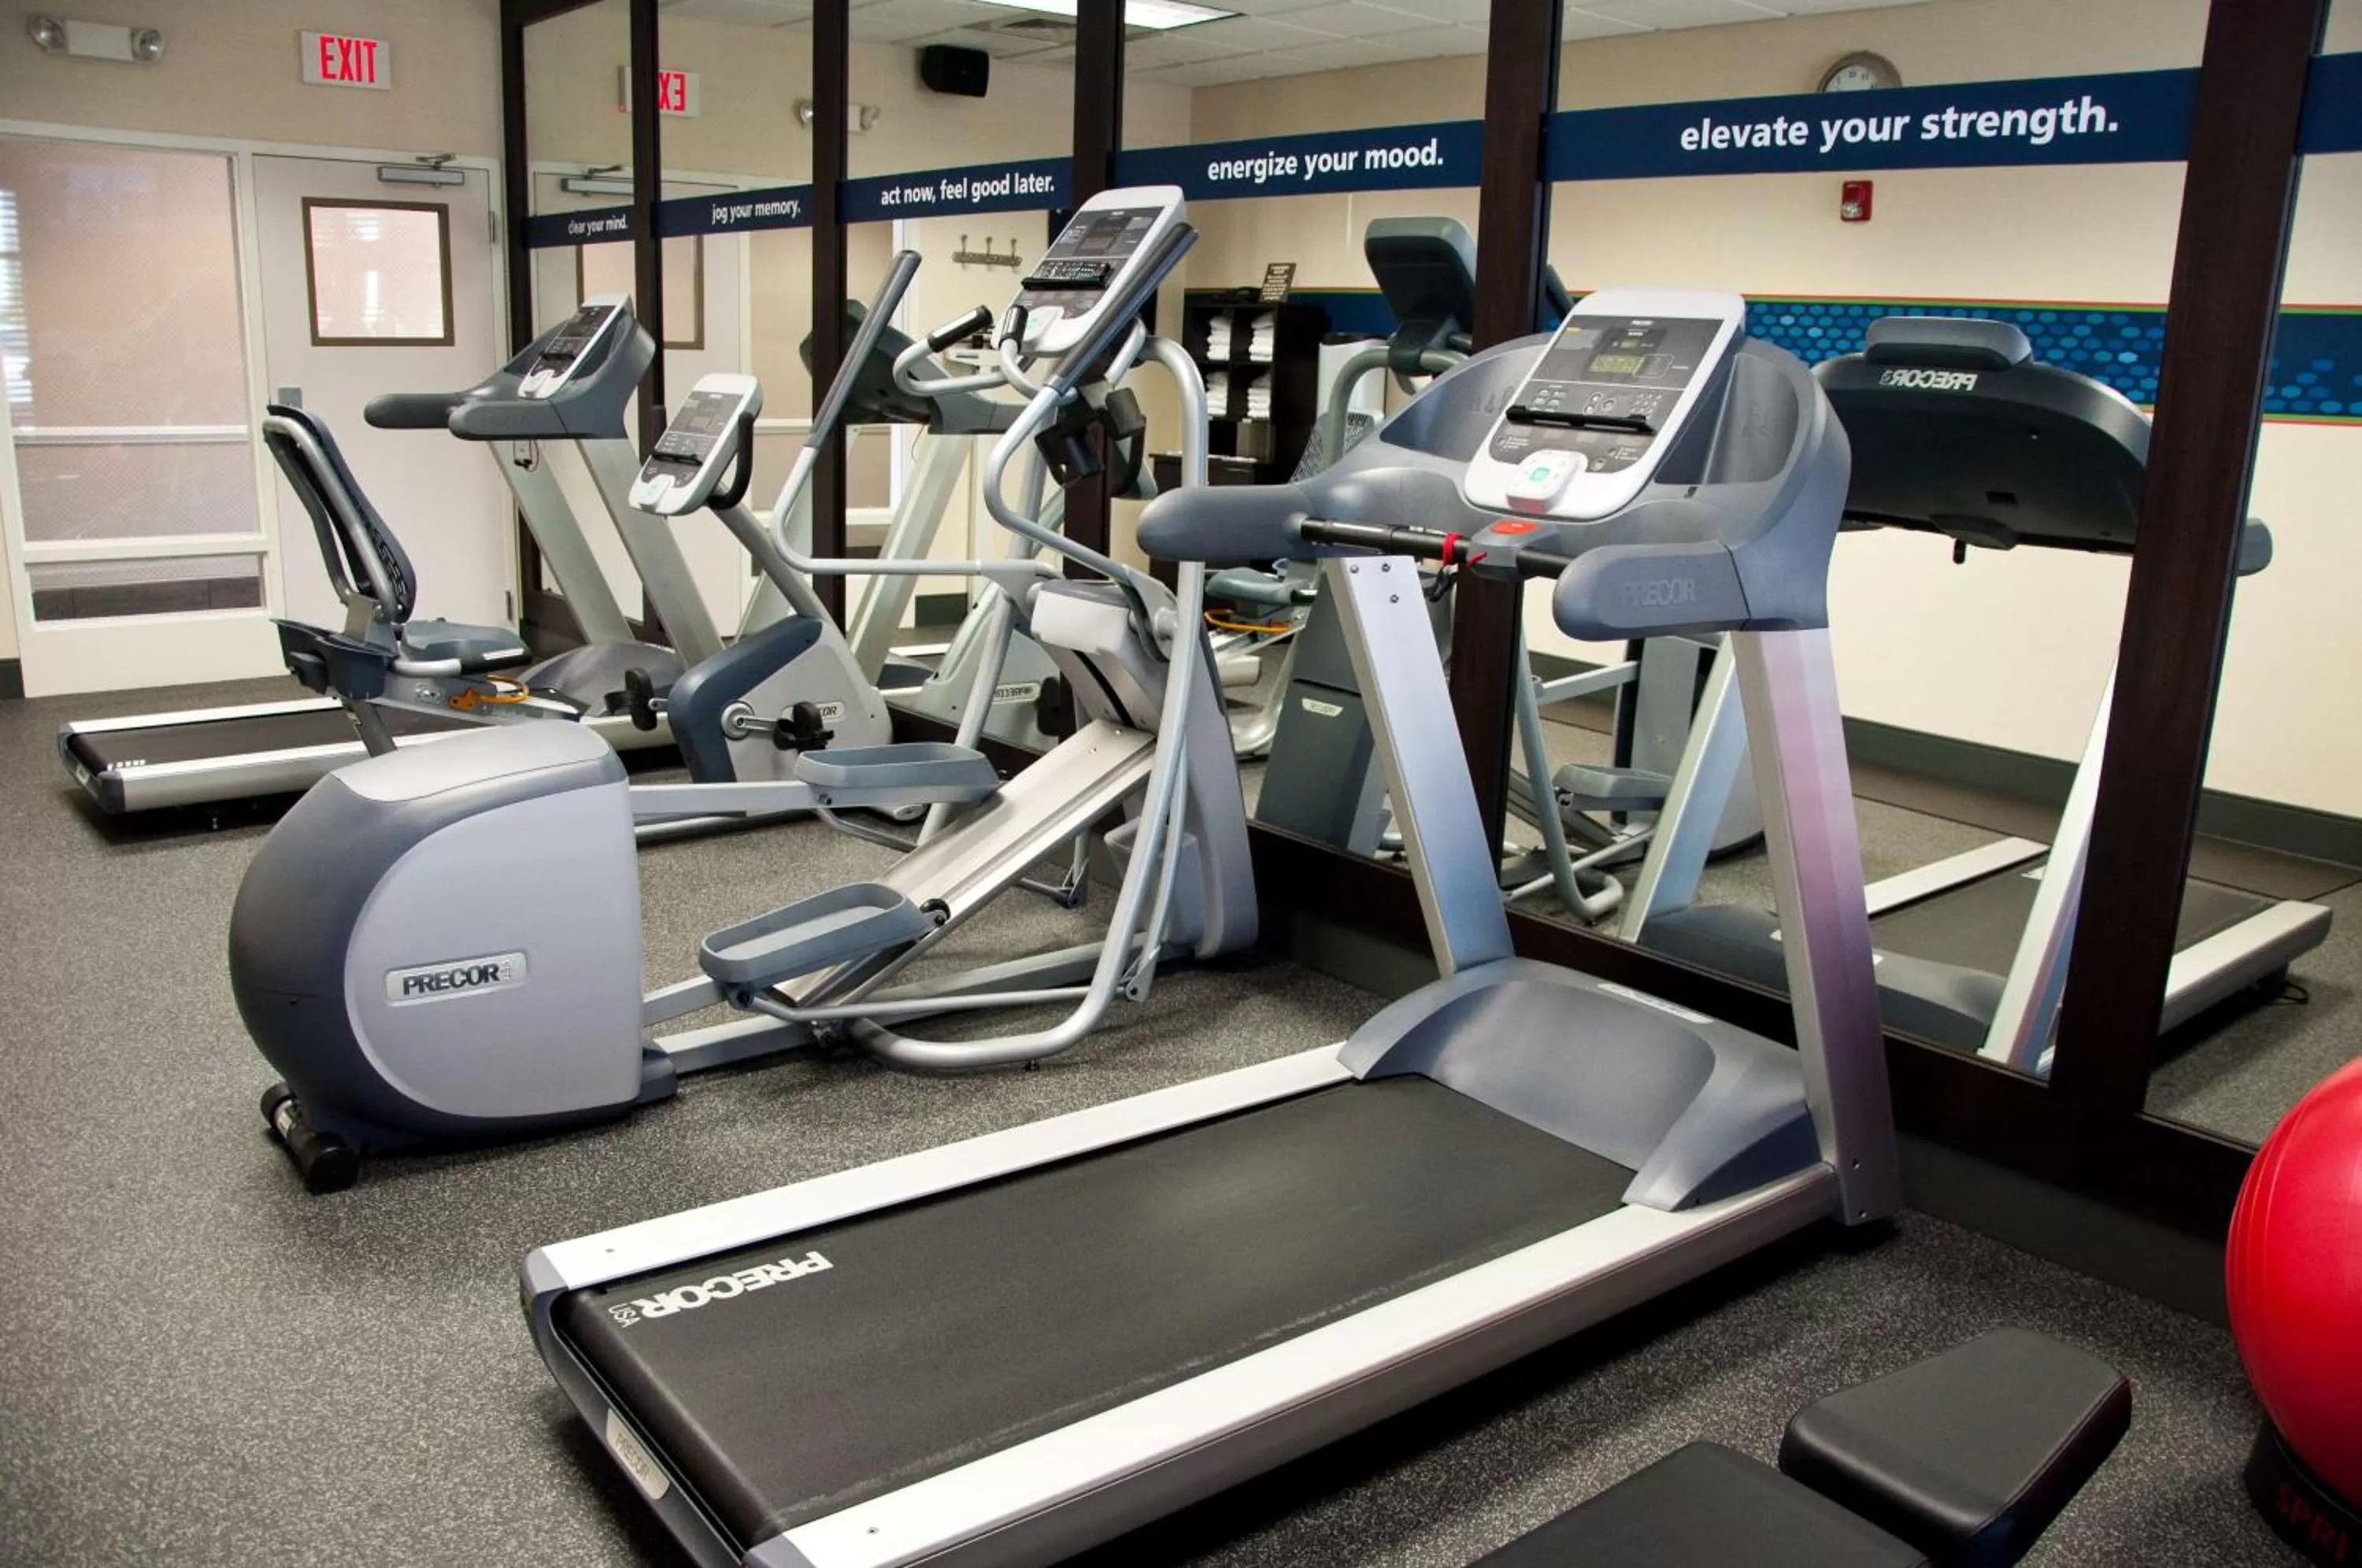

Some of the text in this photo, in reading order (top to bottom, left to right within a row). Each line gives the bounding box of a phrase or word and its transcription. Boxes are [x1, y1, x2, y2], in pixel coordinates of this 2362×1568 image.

[319, 35, 378, 83] EXIT
[1680, 95, 2120, 153] elevate your strength.
[1207, 138, 1443, 183] energize your mood.
[881, 172, 1055, 205] act now, feel good later.
[568, 213, 629, 237] clear your mind.
[711, 200, 802, 225] jog your memory.
[402, 963, 500, 996] PRECOR
[631, 1251, 835, 1318] PRECOR
